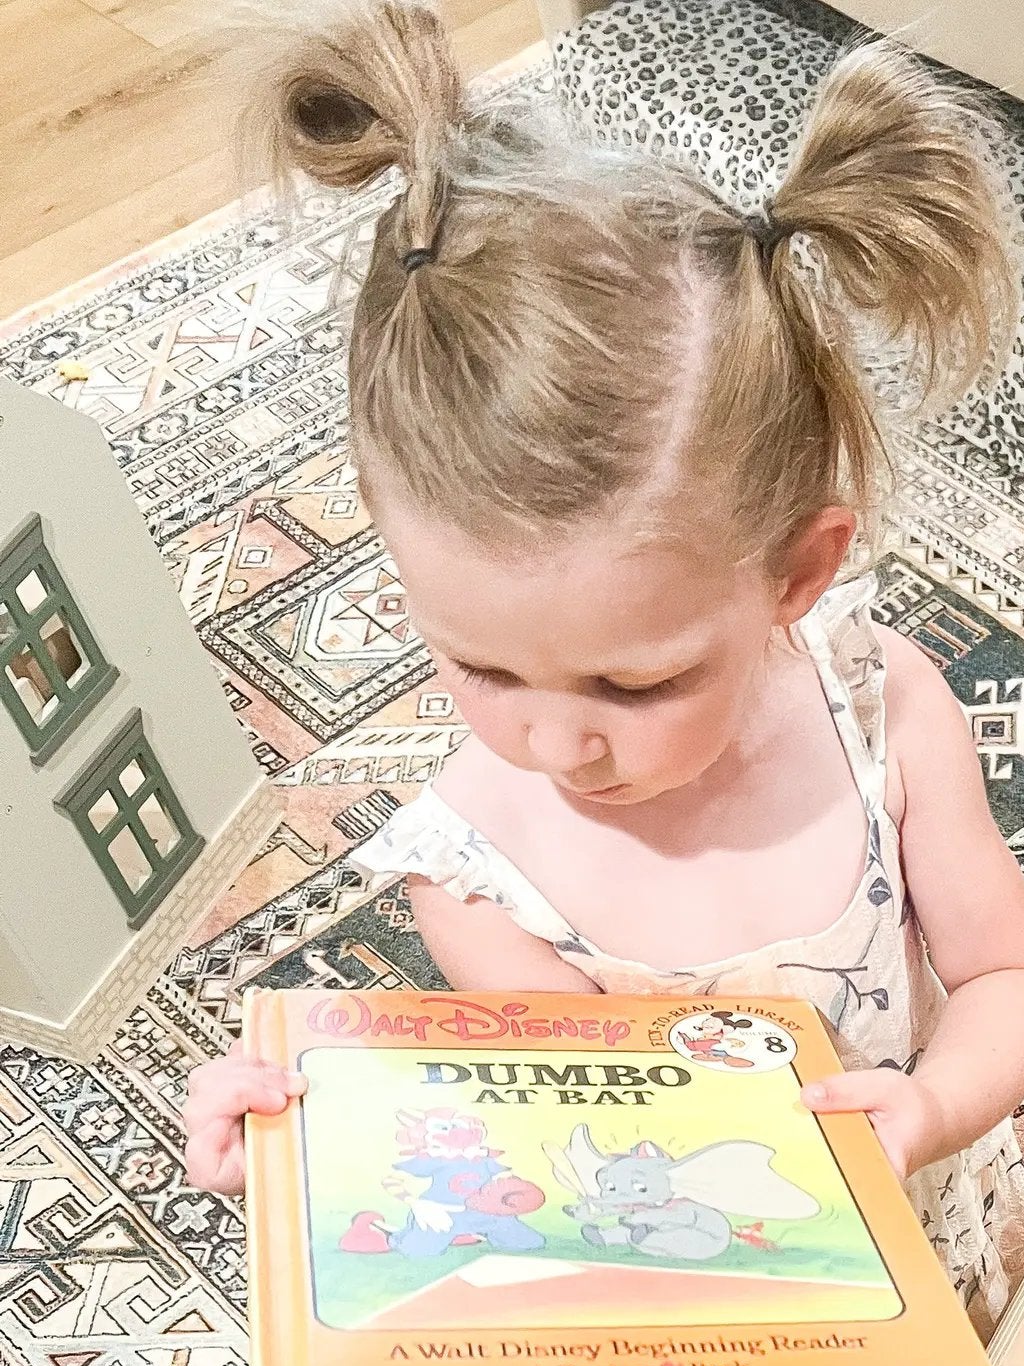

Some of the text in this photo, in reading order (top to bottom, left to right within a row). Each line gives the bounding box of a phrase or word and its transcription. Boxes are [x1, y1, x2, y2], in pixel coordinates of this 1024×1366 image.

[764, 1036, 788, 1053] 8
[417, 1061, 692, 1088] DUMBO
[471, 1089, 655, 1106] AT BAT
[389, 1333, 868, 1361] A Walt Disney Beginning Reader
